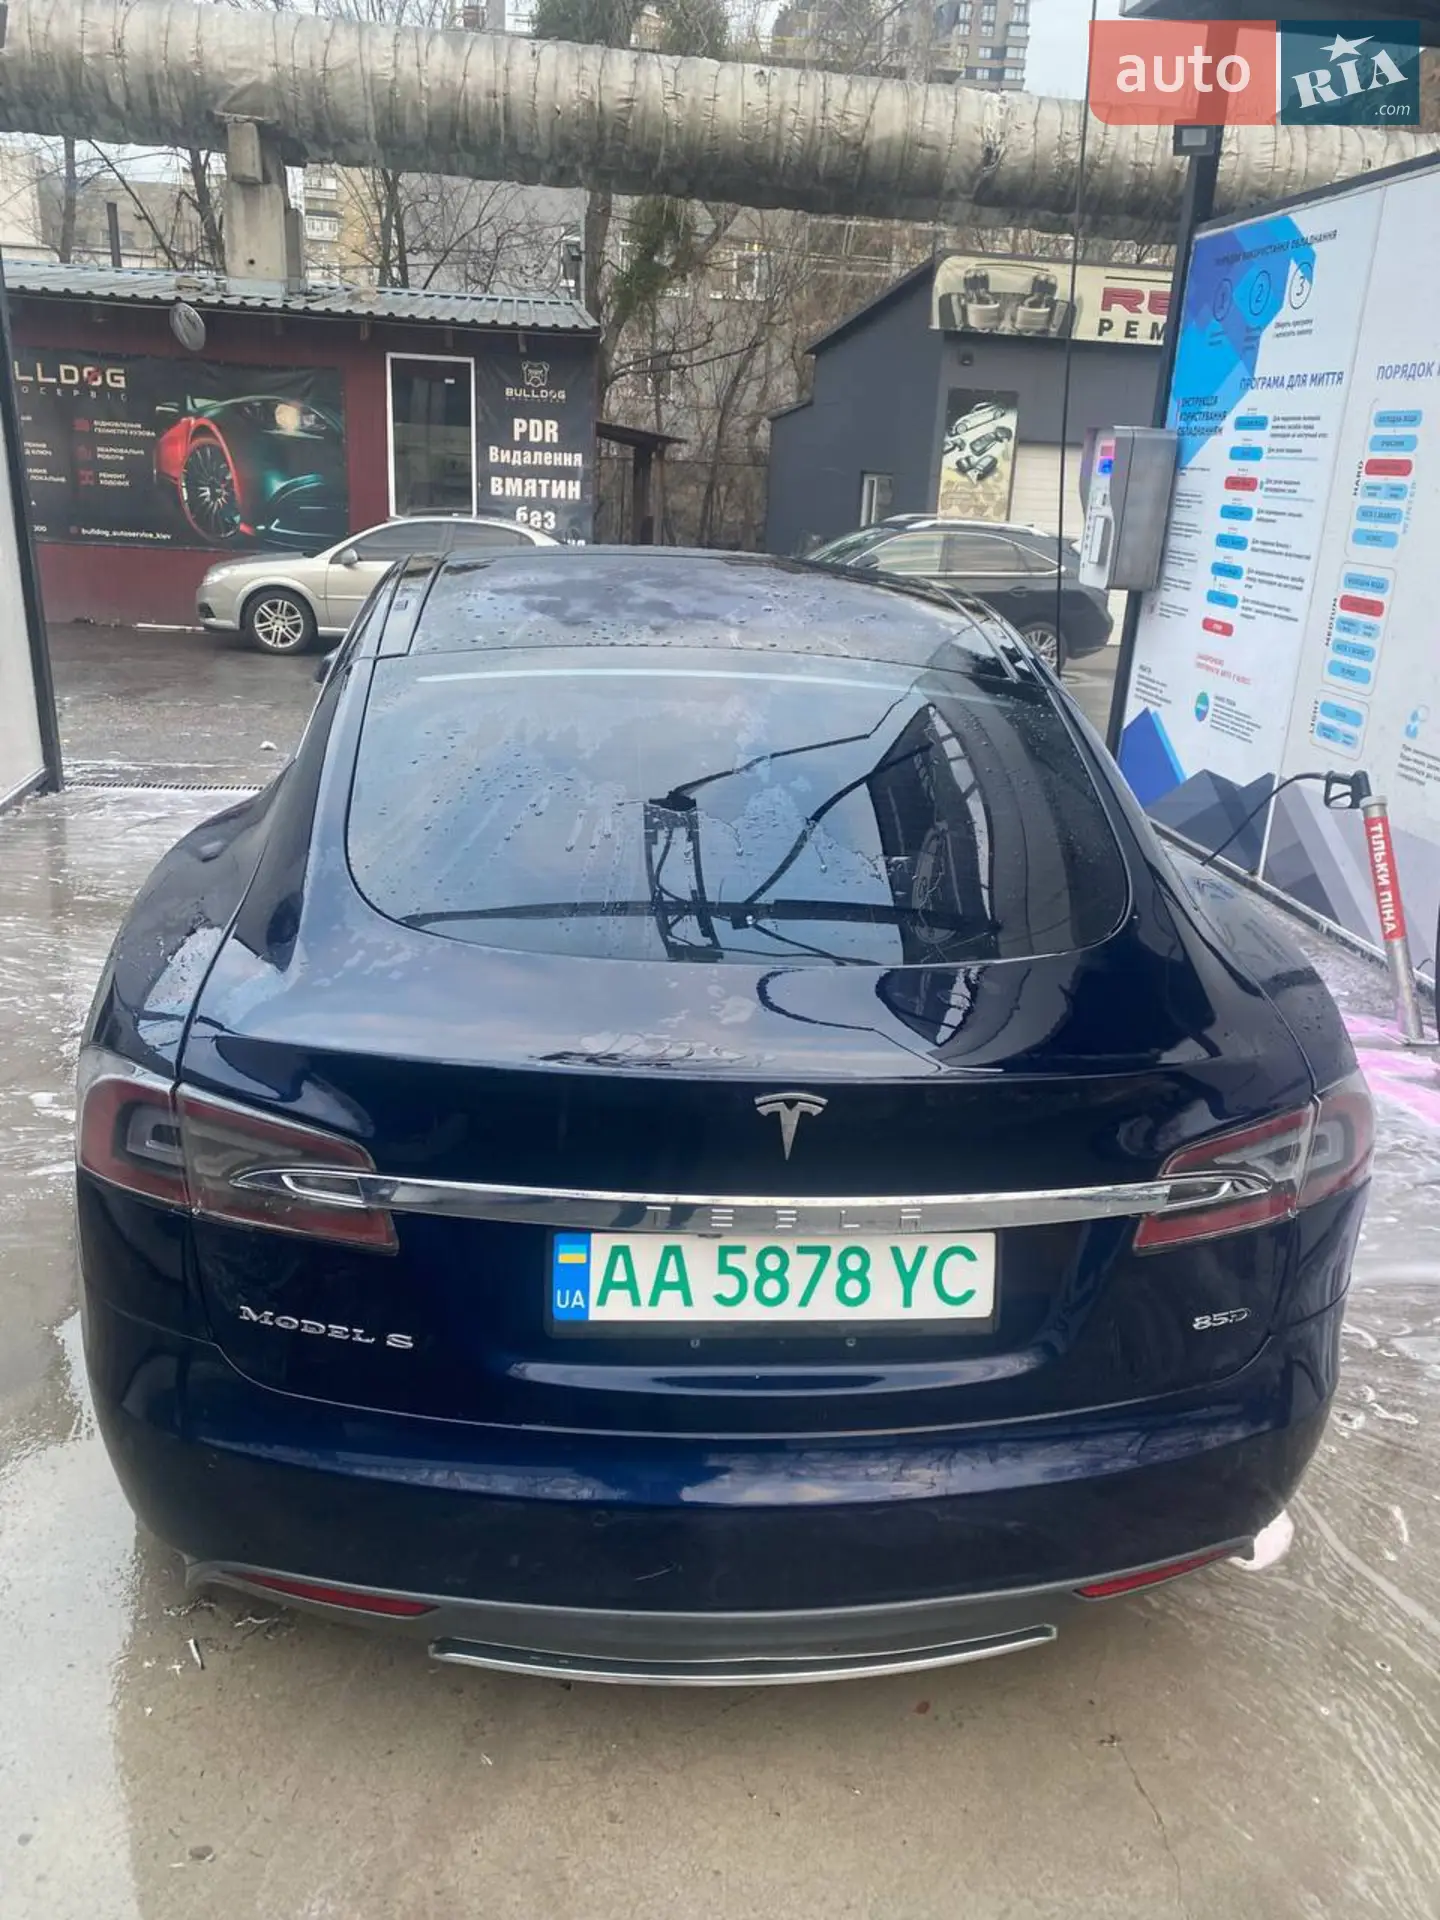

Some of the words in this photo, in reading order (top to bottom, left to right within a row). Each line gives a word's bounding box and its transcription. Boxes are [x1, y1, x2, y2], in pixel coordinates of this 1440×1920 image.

[1255, 283, 1264, 303] 2
[1296, 276, 1305, 296] 3
[1240, 375, 1285, 390] ПРОГРАМА
[1286, 374, 1307, 389] ДЛЯ
[1309, 371, 1344, 386] МИТТЯ
[1377, 362, 1434, 380] ПОРЯДОК
[505, 387, 566, 399] BULLDOG
[513, 418, 558, 443] PDR
[489, 446, 583, 467] Видалення
[491, 476, 581, 500] ВМЯТИН
[516, 506, 556, 530] без
[1370, 822, 1391, 886] ТІЛЬКИ
[1380, 890, 1397, 934] ПІНА
[646, 1205, 922, 1230] TESLA
[596, 1244, 694, 1307] AA
[712, 1244, 871, 1307] 5878
[890, 1244, 978, 1307] YC
[557, 1290, 585, 1309] UA
[239, 1305, 375, 1344] MODEL
[385, 1333, 414, 1350] S
[1192, 1307, 1251, 1330] 85D
